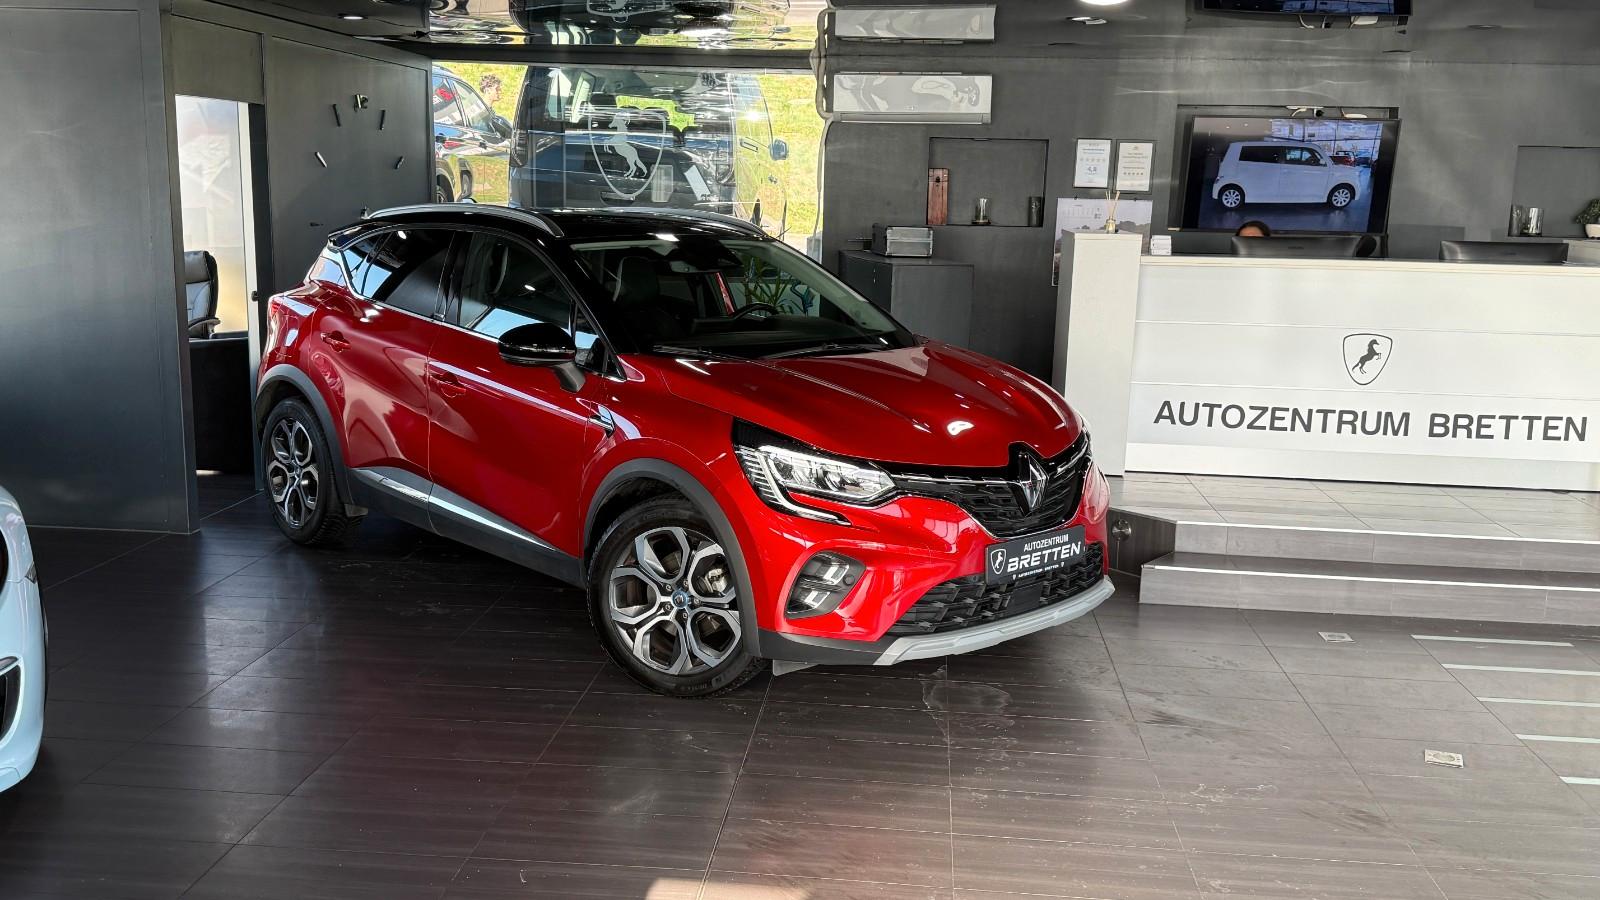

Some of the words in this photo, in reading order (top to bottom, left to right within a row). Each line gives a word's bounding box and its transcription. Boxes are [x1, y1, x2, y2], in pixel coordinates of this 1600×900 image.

[1153, 399, 1410, 437] AUTOZENTRUM
[1427, 412, 1588, 442] BRETTEN
[1007, 541, 1082, 573] BRETTEN
[1023, 533, 1069, 552] AUTOZENTRUM
